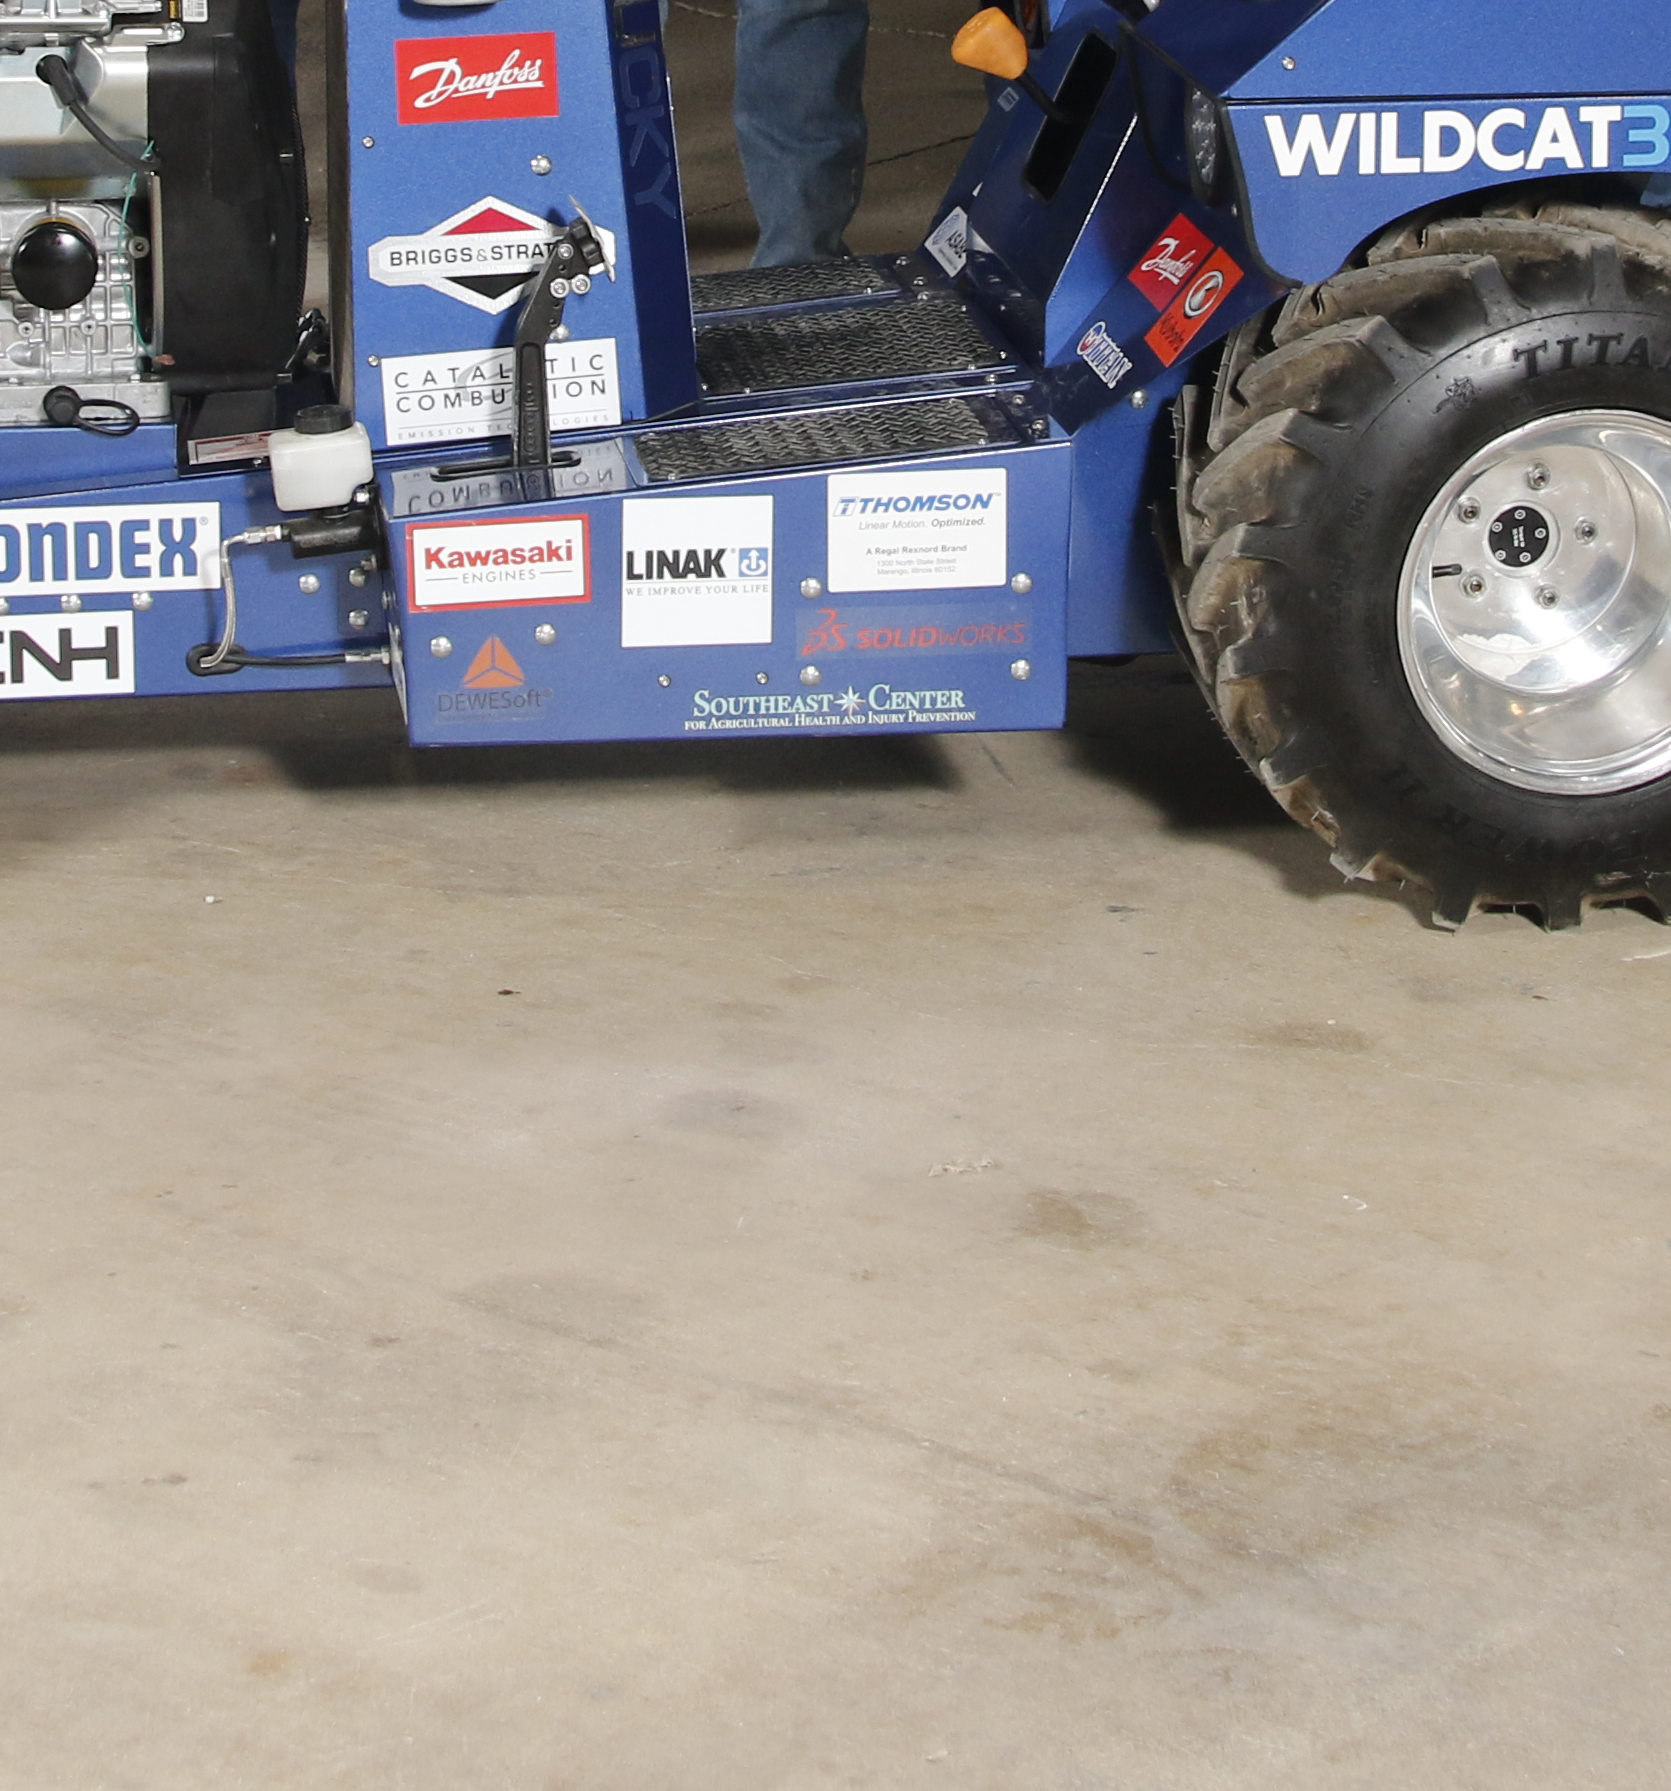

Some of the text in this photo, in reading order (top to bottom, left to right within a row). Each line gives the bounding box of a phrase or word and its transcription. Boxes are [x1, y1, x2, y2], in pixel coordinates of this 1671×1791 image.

[409, 49, 545, 108] Danfoss
[394, 355, 605, 388] CATALTIC
[396, 379, 606, 413] COMBUION
[398, 426, 475, 440] EMISSION
[859, 493, 993, 513] THOMSON
[859, 520, 890, 530] Linear
[931, 517, 987, 528] Optimized.
[424, 539, 573, 570] Kawasaki
[875, 546, 899, 556] Regal
[941, 544, 967, 552] Brand
[626, 548, 728, 580] LINAK
[462, 568, 536, 585] ENGINES
[626, 584, 769, 596] WE IMPROVE YOUR LIFE
[857, 623, 1026, 650] SOLIDWORKS
